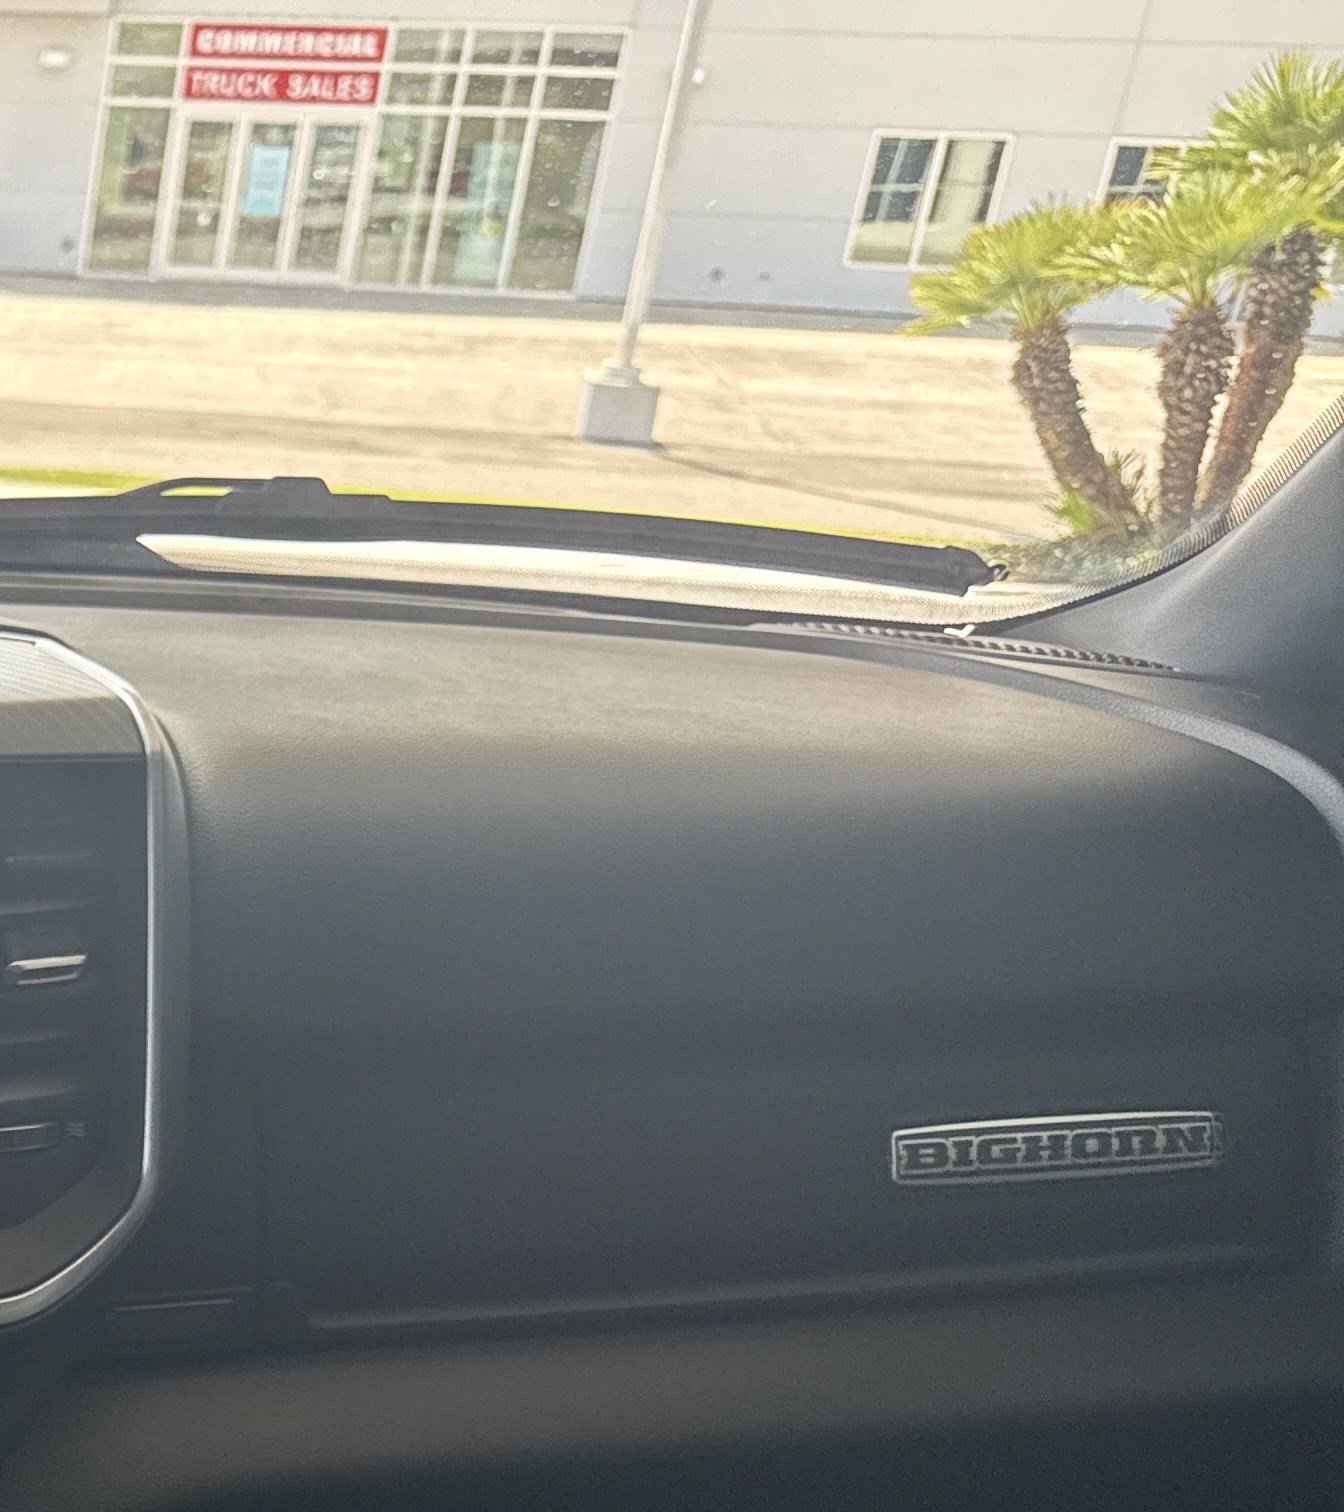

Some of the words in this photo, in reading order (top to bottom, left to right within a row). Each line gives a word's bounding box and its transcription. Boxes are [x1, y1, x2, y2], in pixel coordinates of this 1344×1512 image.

[196, 26, 379, 58] COMMERCIAL
[190, 69, 278, 99] TRUCK
[286, 71, 375, 101] SALES
